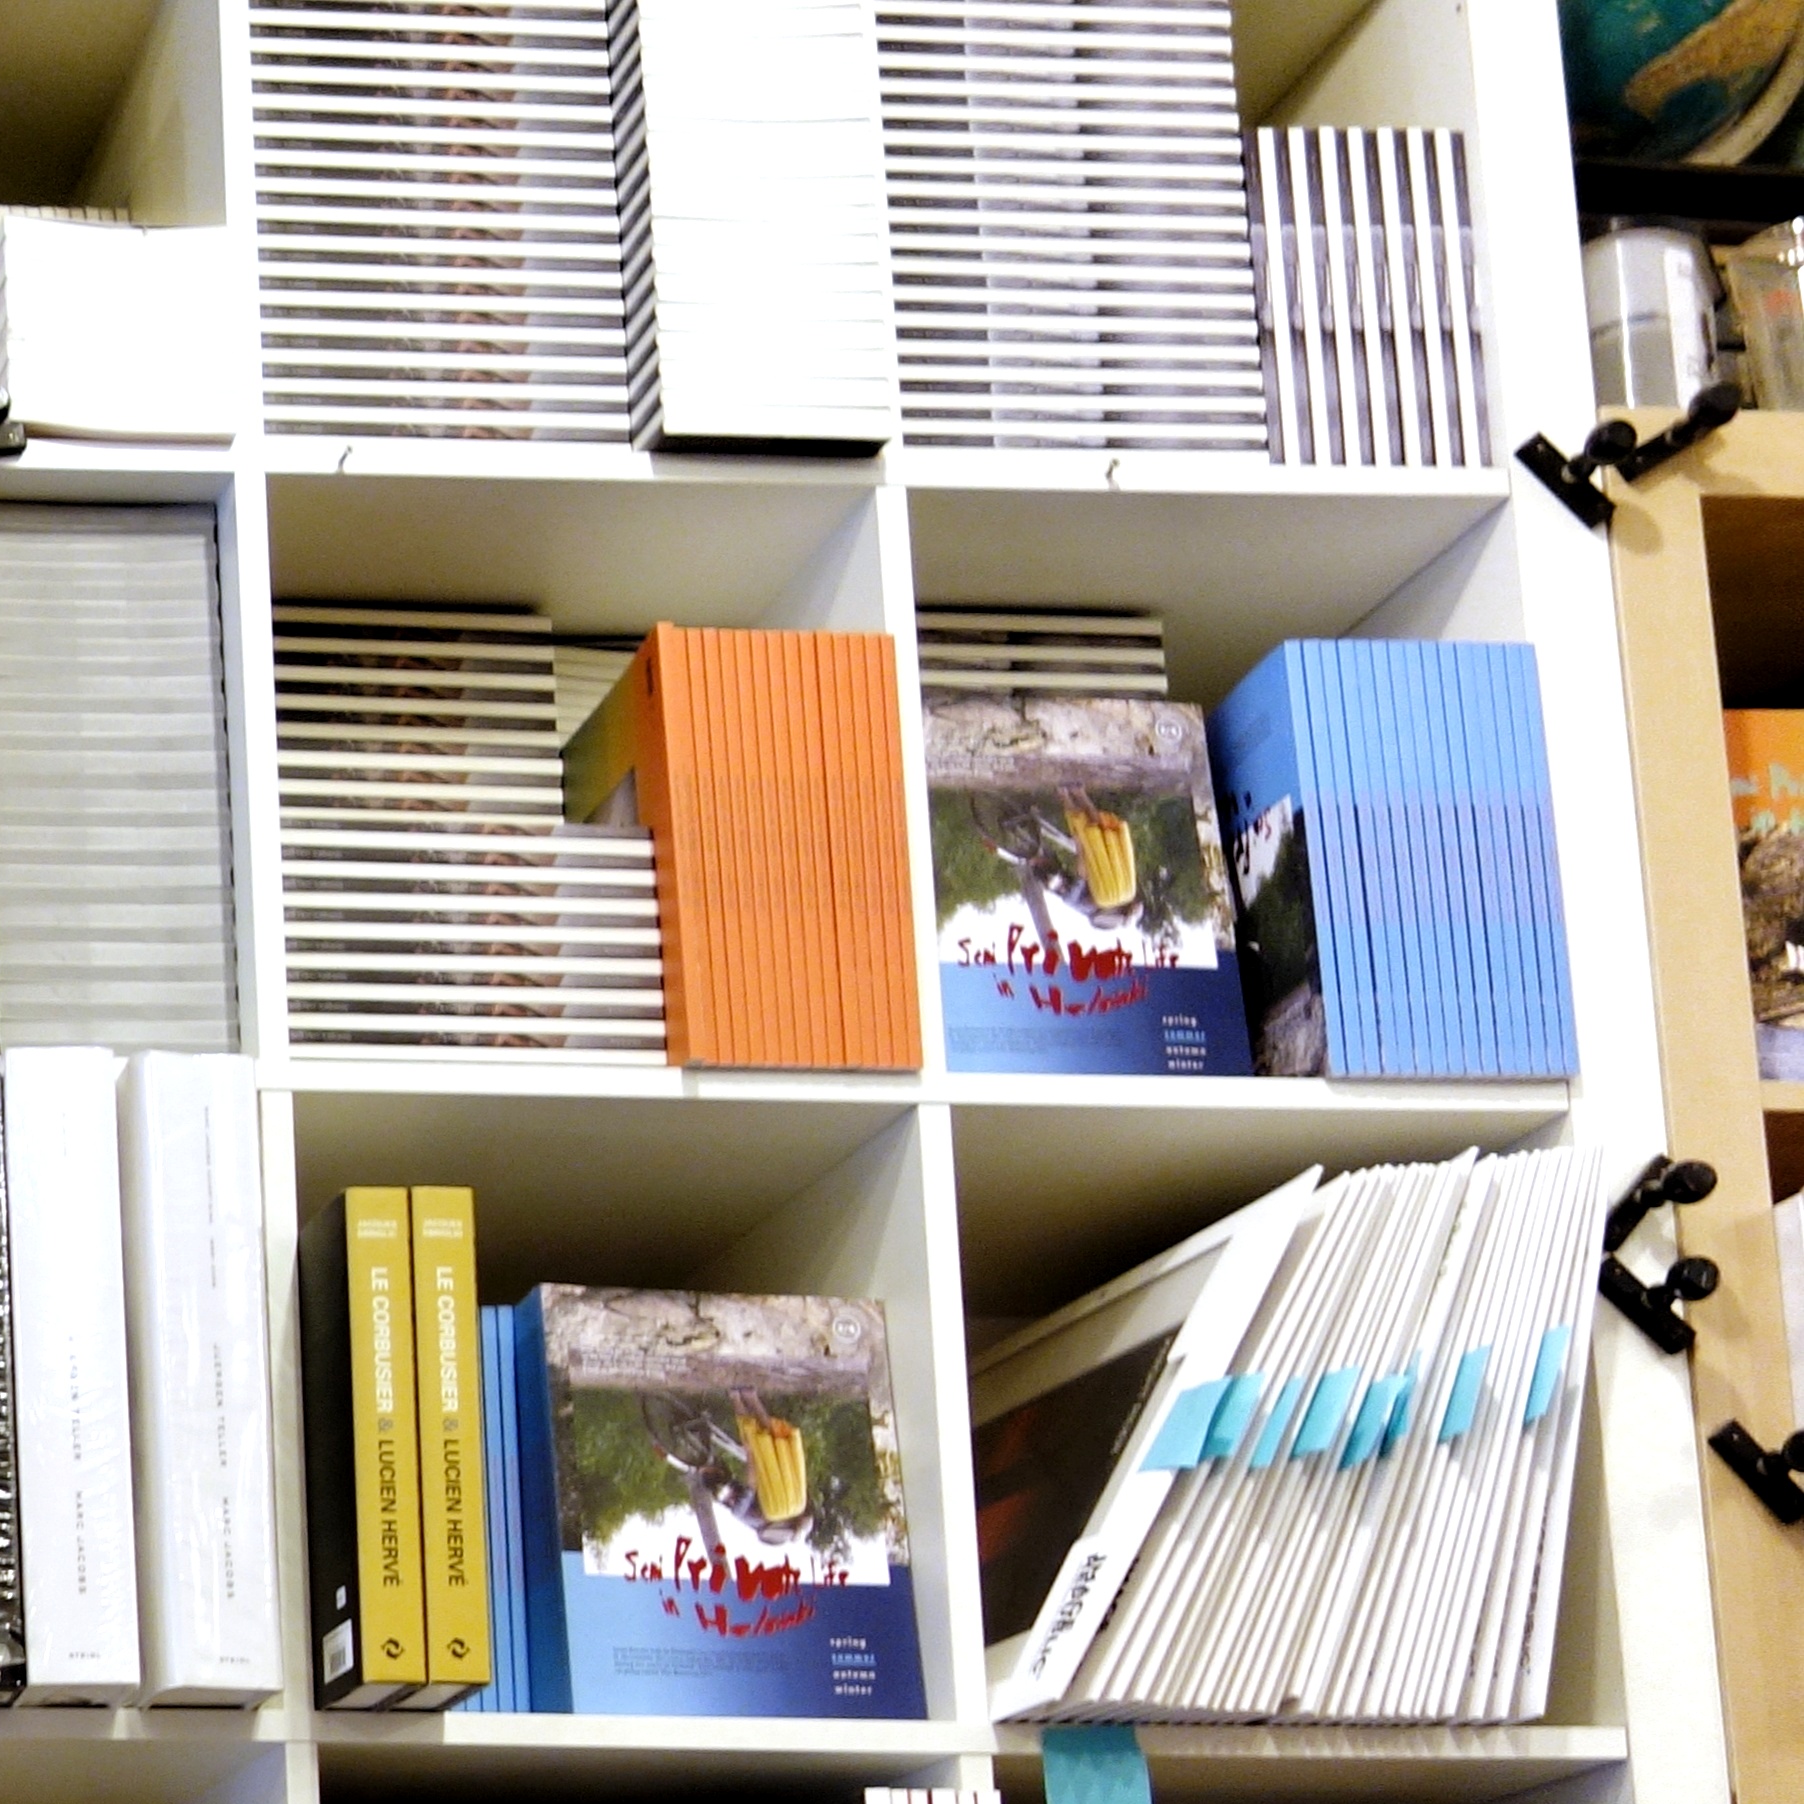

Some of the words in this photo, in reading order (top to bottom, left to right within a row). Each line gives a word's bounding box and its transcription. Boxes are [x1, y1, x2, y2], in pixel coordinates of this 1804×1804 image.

[372, 1267, 388, 1290] LE
[373, 1299, 393, 1412] CORBUSIER
[378, 1440, 396, 1512] LUCIEN
[382, 1519, 402, 1587] HERVÉ
